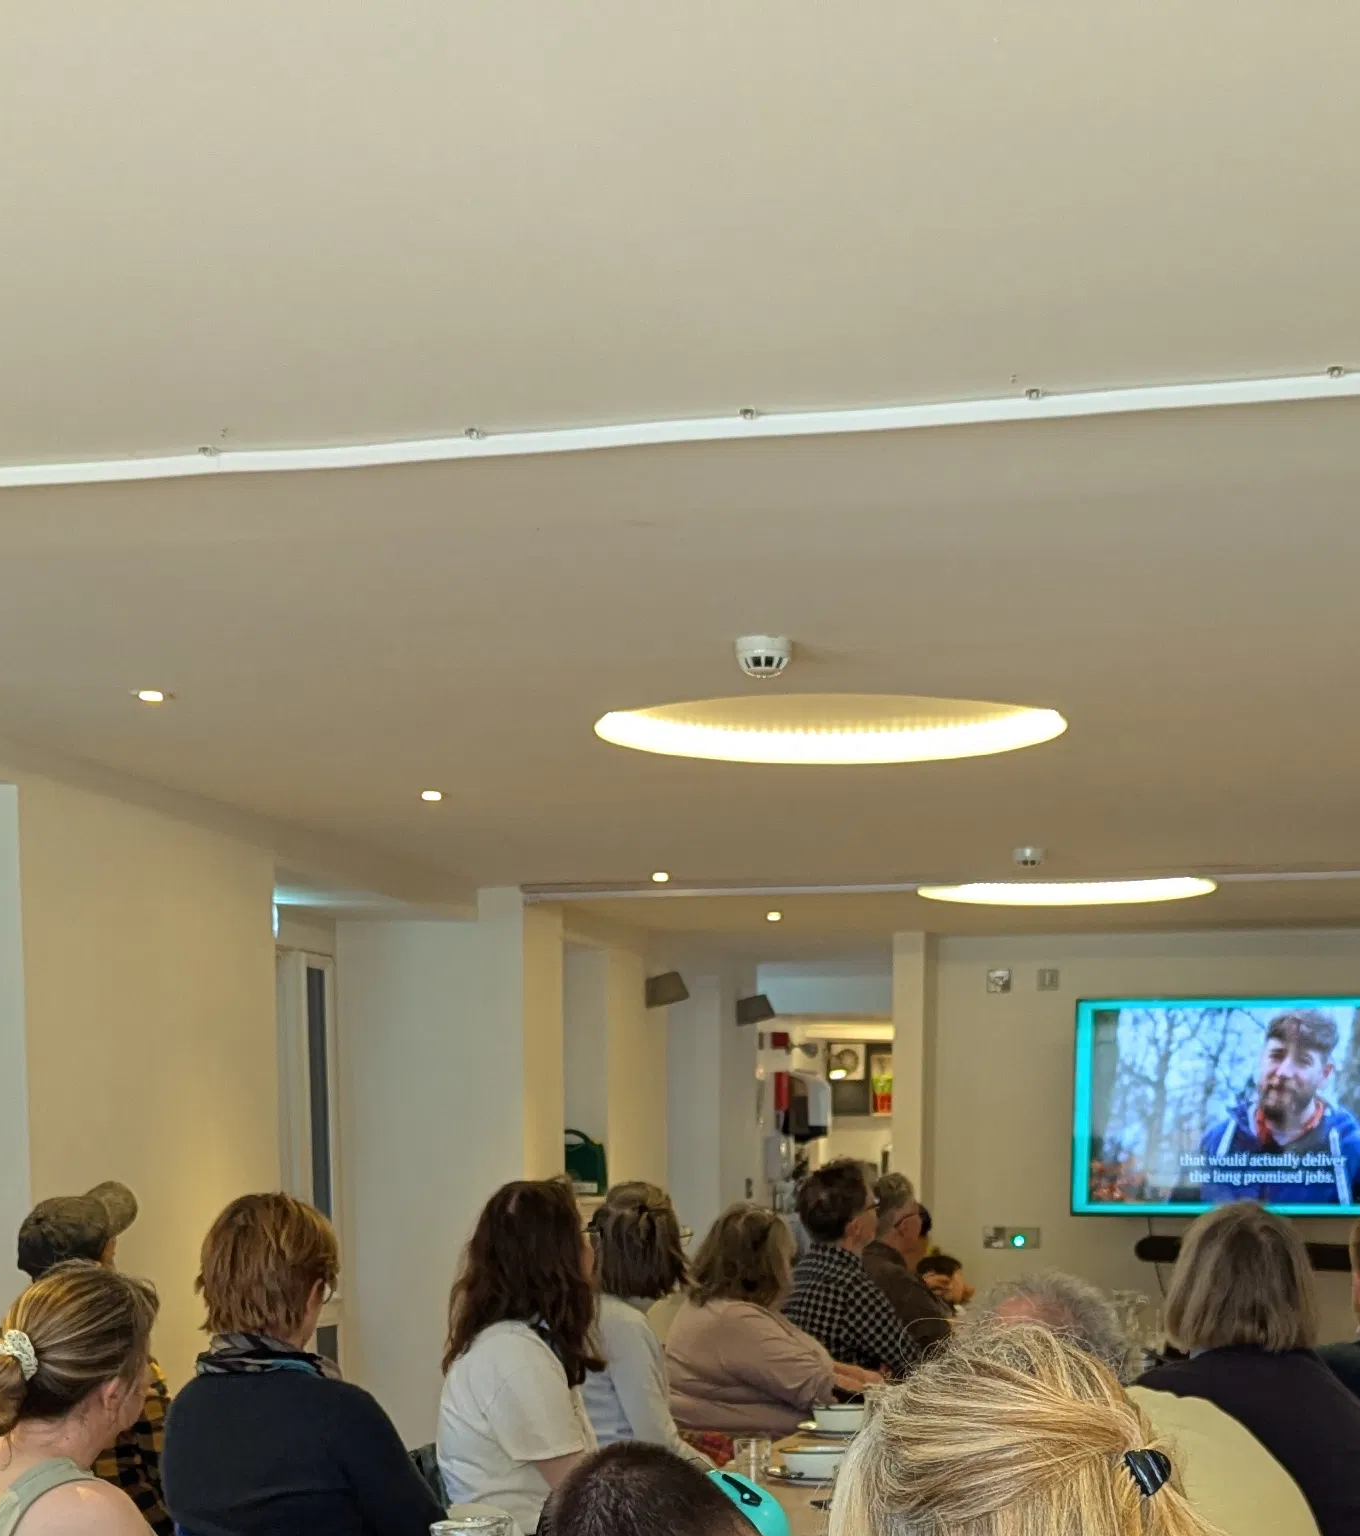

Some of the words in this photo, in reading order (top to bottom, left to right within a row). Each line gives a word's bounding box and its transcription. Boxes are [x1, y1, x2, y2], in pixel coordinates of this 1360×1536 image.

[1179, 1152, 1206, 1168] that
[1208, 1151, 1248, 1168] would
[1249, 1151, 1301, 1169] actually
[1301, 1151, 1347, 1168] deliver
[1189, 1168, 1211, 1184] the
[1212, 1169, 1241, 1186] long
[1243, 1168, 1304, 1186] promised
[1304, 1169, 1336, 1186] jobs.
